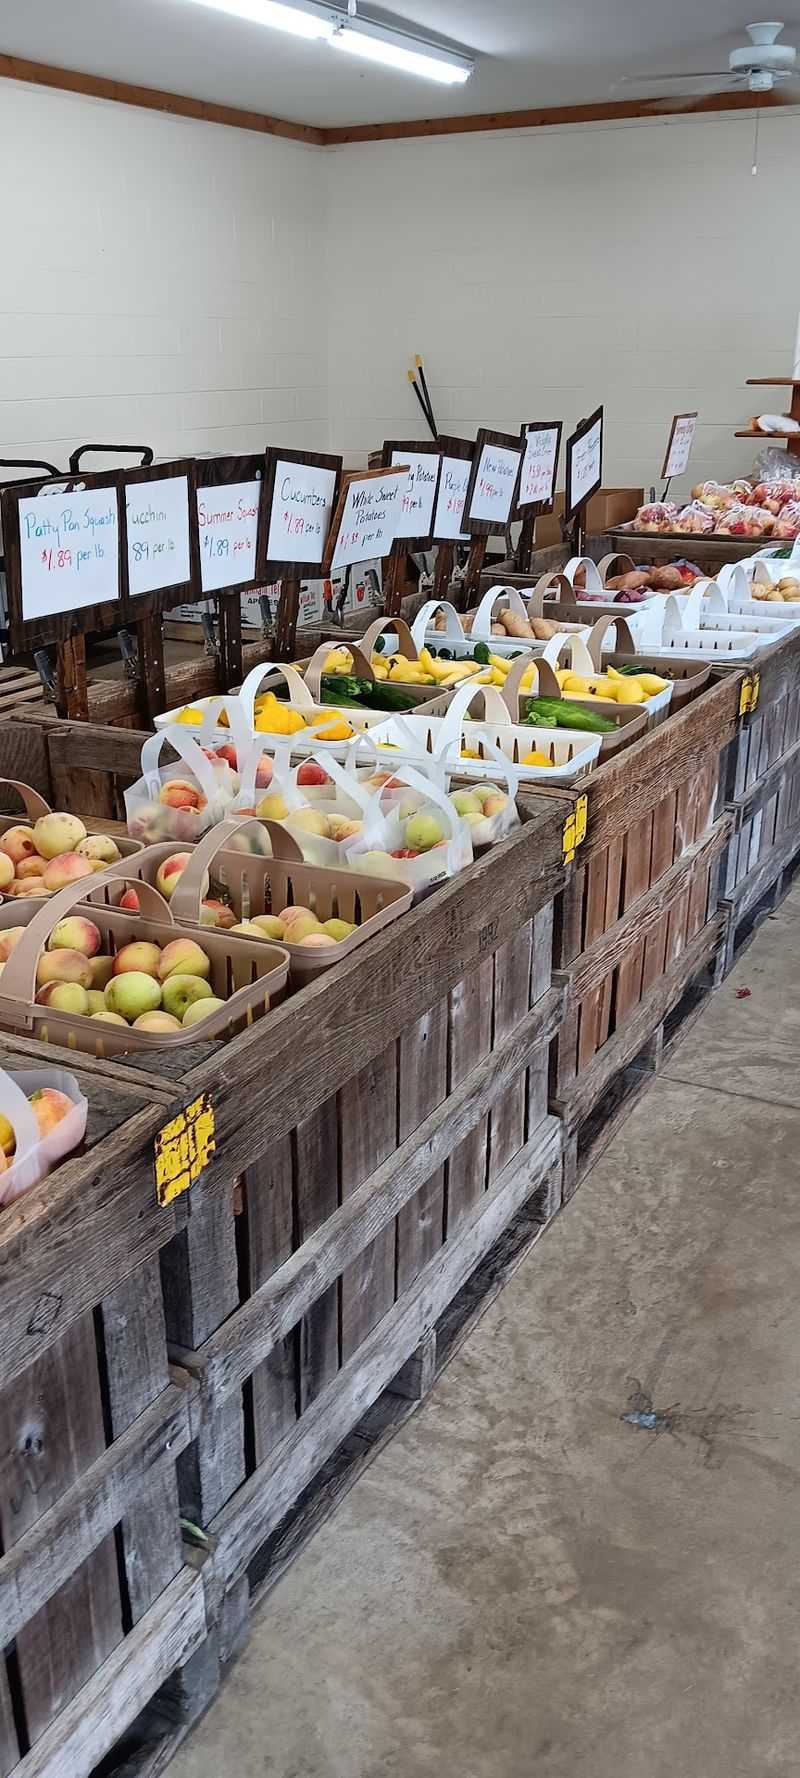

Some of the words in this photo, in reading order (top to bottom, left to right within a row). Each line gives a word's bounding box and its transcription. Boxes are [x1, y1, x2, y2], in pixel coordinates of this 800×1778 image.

[281, 477, 326, 507] Cucumbers
[375, 484, 398, 503] Sweet
[126, 503, 167, 525] ucchini
[199, 502, 234, 527] Summer
[283, 511, 305, 535] $1.89
[356, 509, 387, 526] Potatoes
[24, 512, 60, 548] Patty
[61, 509, 80, 532] Pan
[83, 506, 116, 536] Squash
[41, 548, 72, 571] $1.89
[77, 550, 91, 571] per
[94, 543, 104, 559] lb
[203, 535, 229, 558] $1.89
